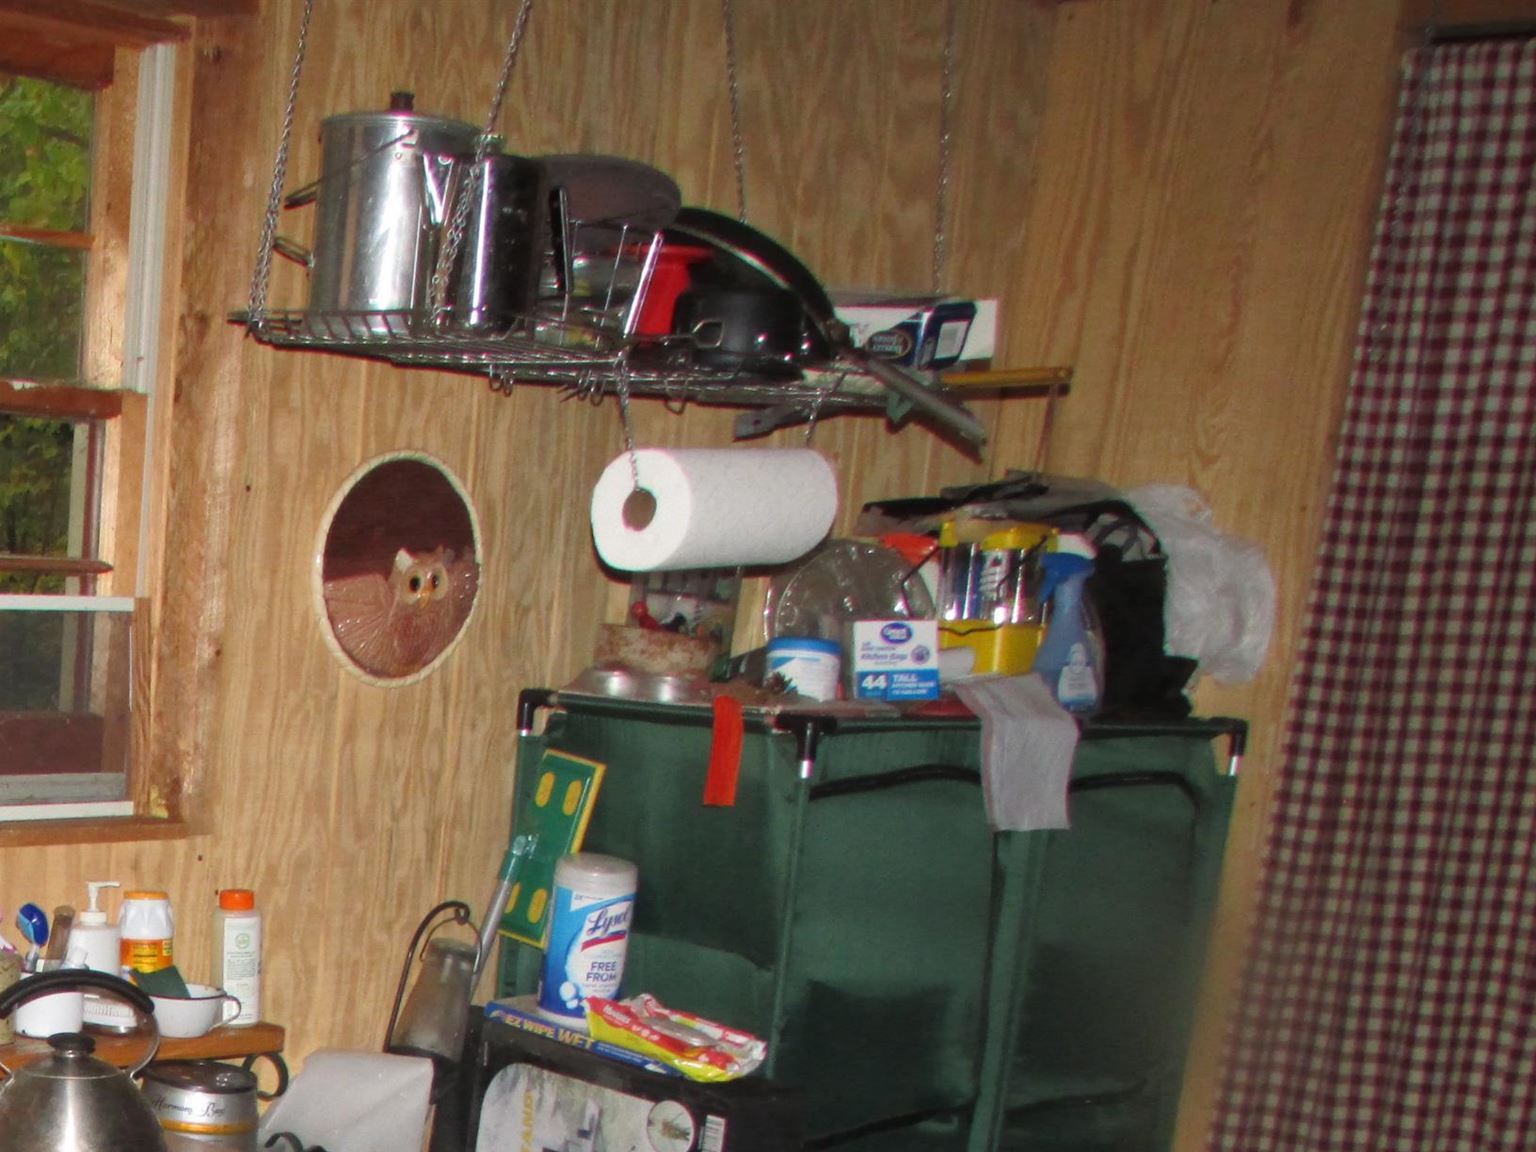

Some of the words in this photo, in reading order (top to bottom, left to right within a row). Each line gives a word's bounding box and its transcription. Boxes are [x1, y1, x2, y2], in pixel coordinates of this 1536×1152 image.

[861, 674, 887, 690] 44
[591, 961, 617, 972] FREE
[585, 972, 616, 982] FROM
